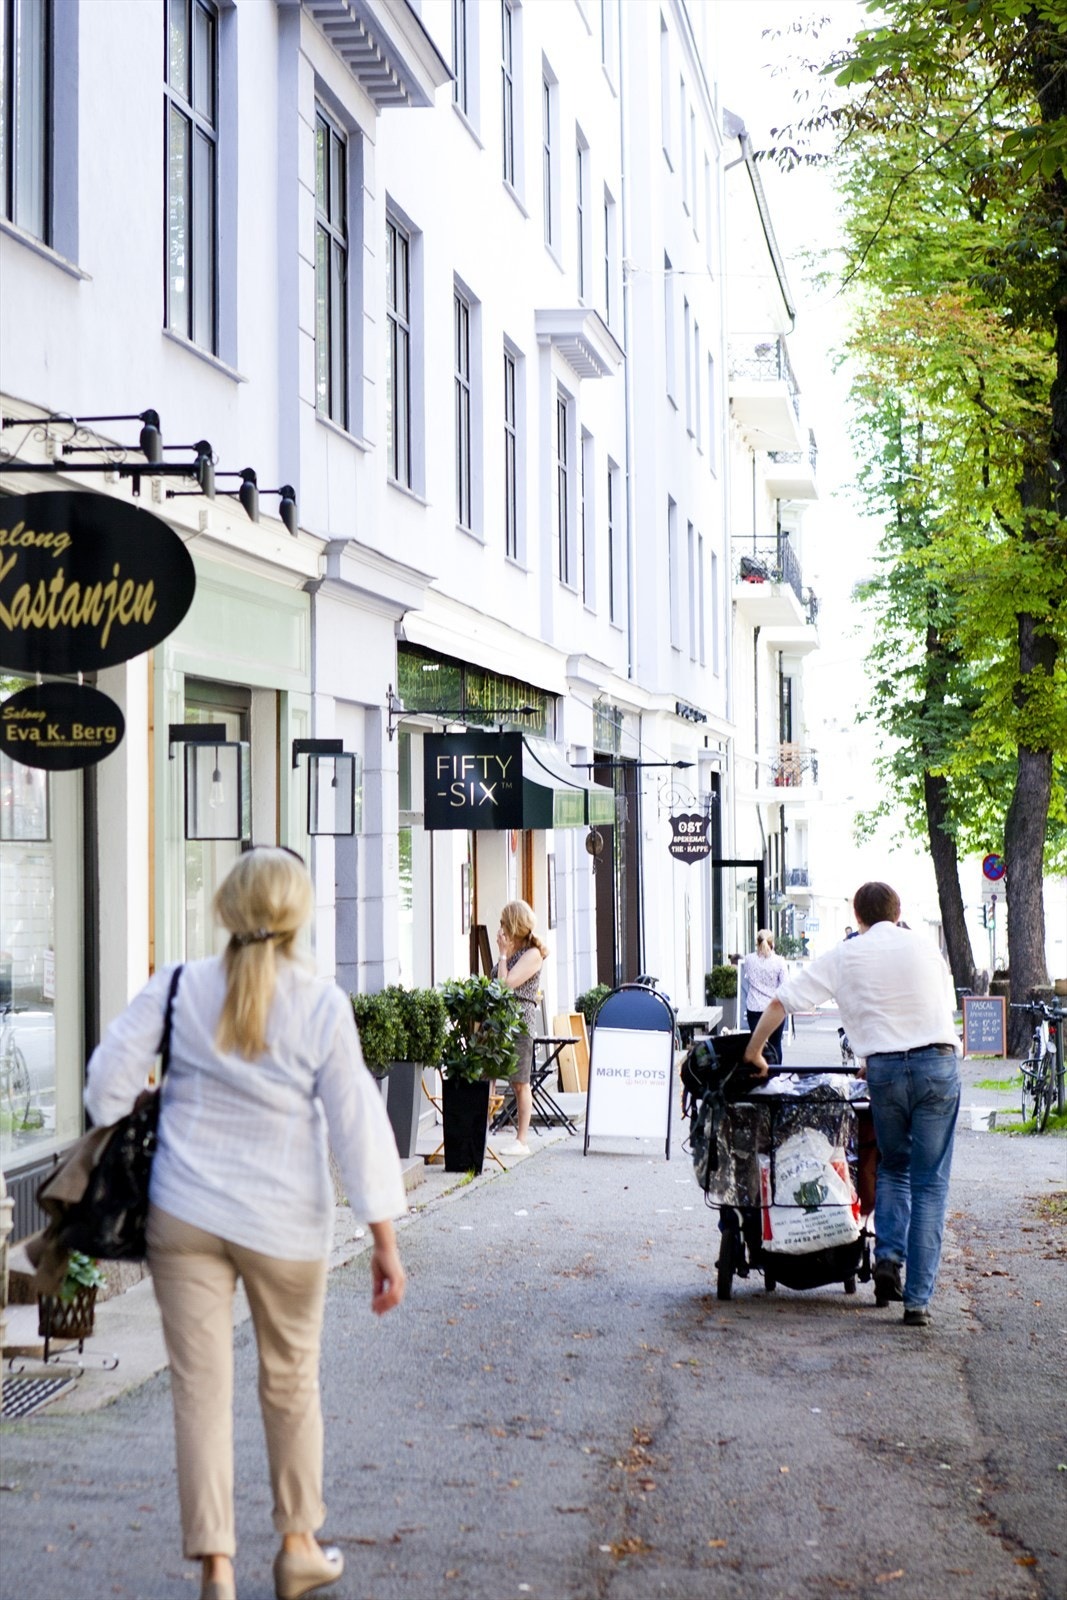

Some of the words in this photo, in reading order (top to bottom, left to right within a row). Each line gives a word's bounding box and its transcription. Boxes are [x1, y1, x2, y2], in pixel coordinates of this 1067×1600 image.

[6, 724, 40, 741] Eva
[47, 724, 65, 740] K.
[72, 723, 116, 743] Berg
[437, 755, 513, 780] FIFTY
[437, 782, 498, 807] -SIX
[678, 821, 703, 833] OST
[971, 1001, 994, 1010] PASCAL
[634, 1069, 666, 1080] POTS
